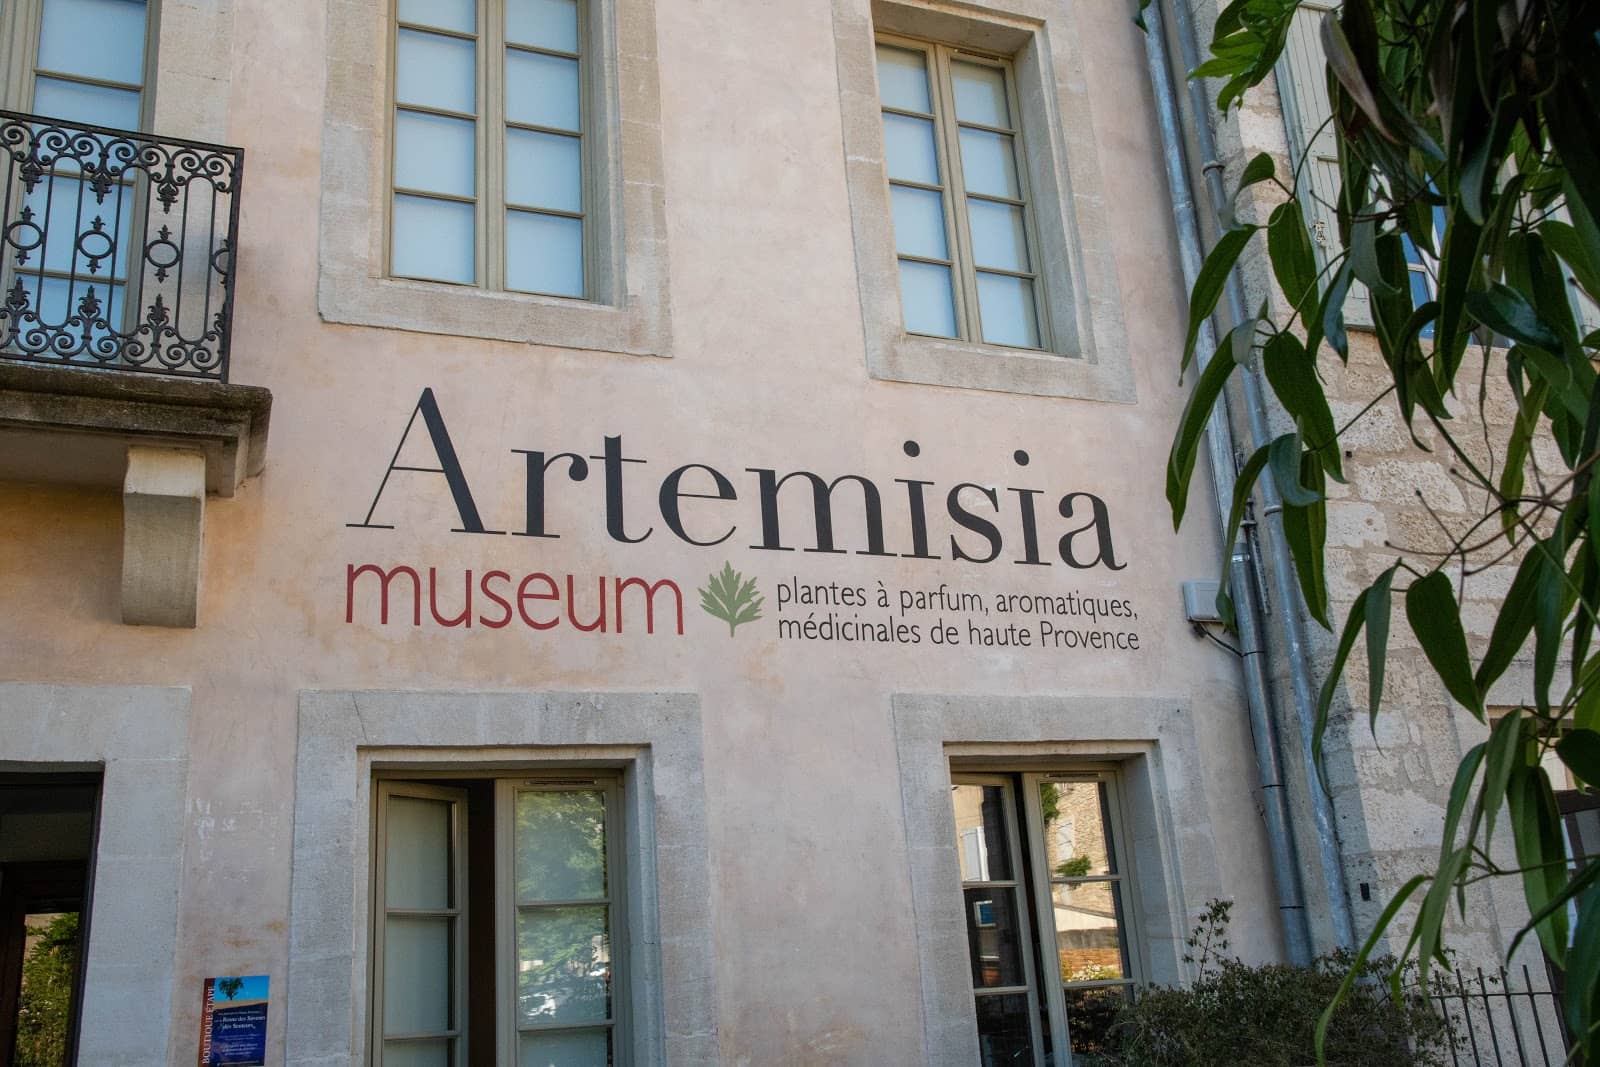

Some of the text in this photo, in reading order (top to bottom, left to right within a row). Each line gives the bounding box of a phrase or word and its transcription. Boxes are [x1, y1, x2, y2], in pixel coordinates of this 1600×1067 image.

[345, 387, 1128, 571] Artemisia
[345, 563, 684, 636] museum
[777, 576, 1138, 623] plantes à parfum, aromatiques,
[778, 612, 1140, 651] médicinales de haute Provence
[202, 1015, 213, 1064] BOUTIQUE
